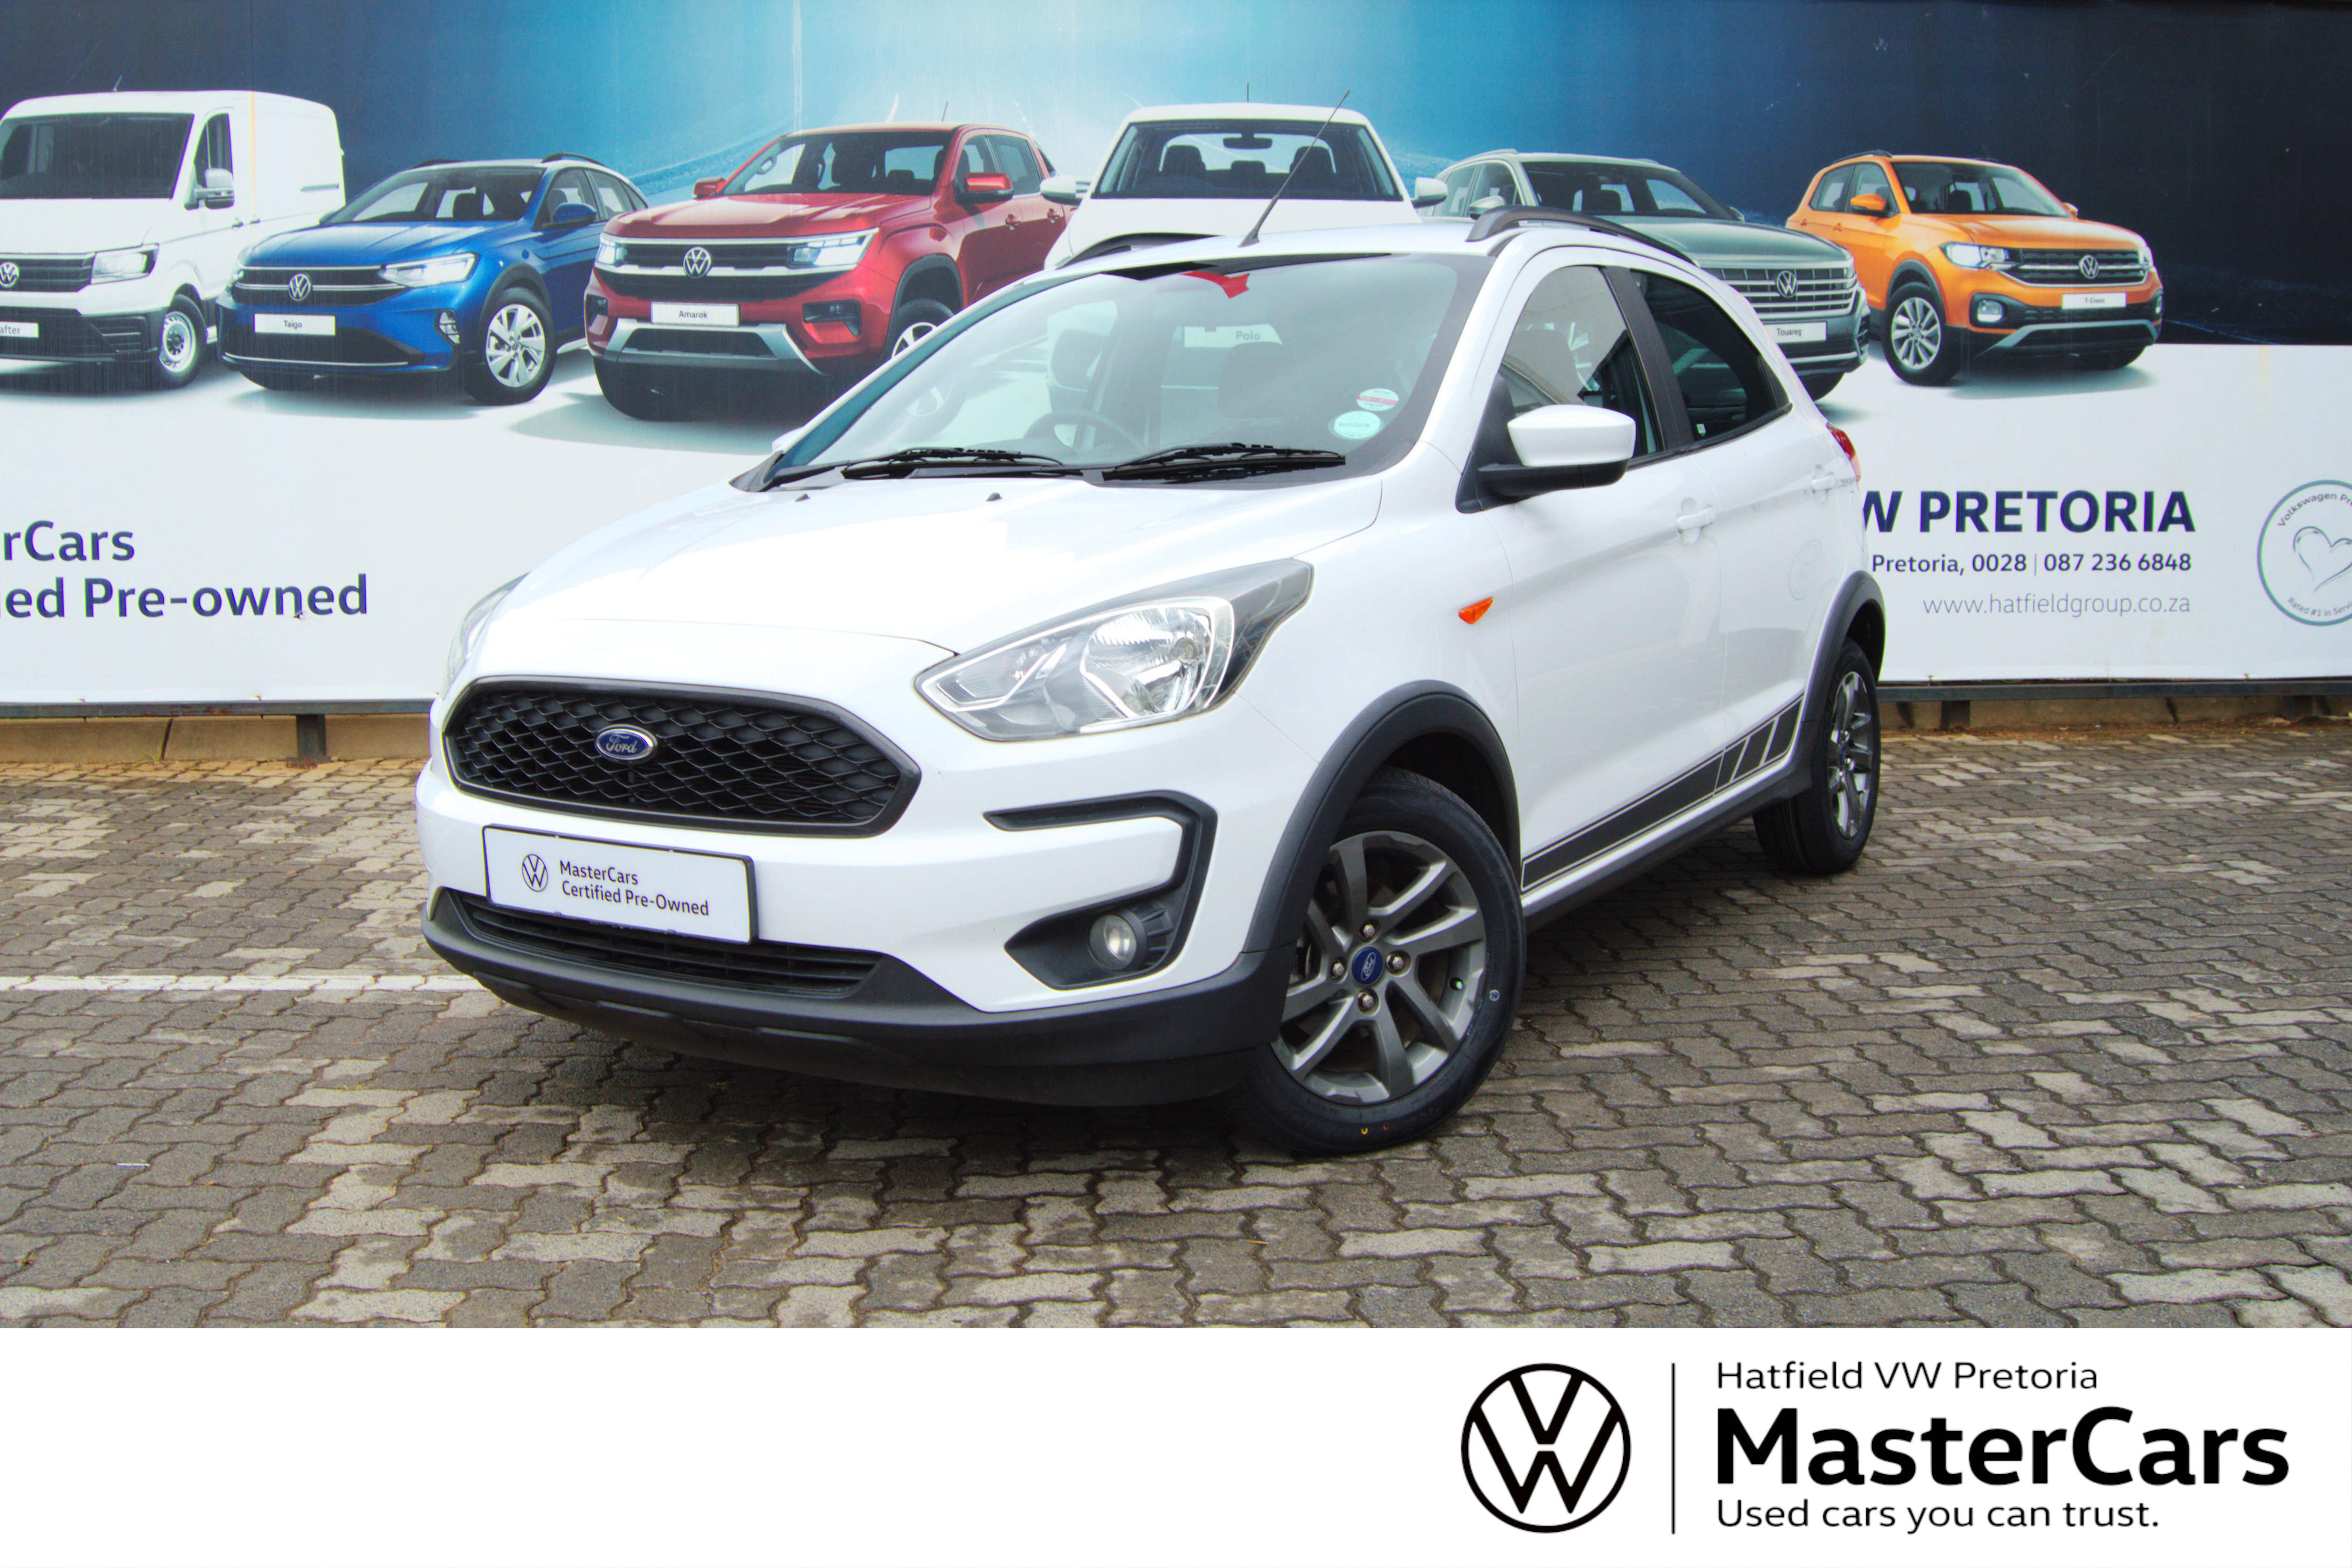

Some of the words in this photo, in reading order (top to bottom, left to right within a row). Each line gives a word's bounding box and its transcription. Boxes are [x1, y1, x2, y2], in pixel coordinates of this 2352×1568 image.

[284, 320, 302, 330] Taigo
[678, 310, 708, 319] Amarok
[1235, 331, 1261, 340] Polo
[1777, 328, 1802, 337] Touareg
[1919, 490, 2196, 533] PRETORIA
[2277, 493, 2338, 526] Volkswagen
[3, 521, 135, 561] rCars
[1872, 553, 1965, 577] Pretoria,
[1972, 553, 2027, 572] 0028
[2044, 553, 2084, 571] 087
[2091, 553, 2132, 571] 236
[2138, 553, 2191, 571] 6848
[85, 573, 367, 617] Pre-owned
[1922, 593, 2191, 618] www.hatfieldgroup.co.za
[606, 734, 638, 753] Ford
[560, 860, 638, 885] MasterCars
[562, 880, 621, 903] Certified
[625, 890, 710, 916] Pre-Owned
